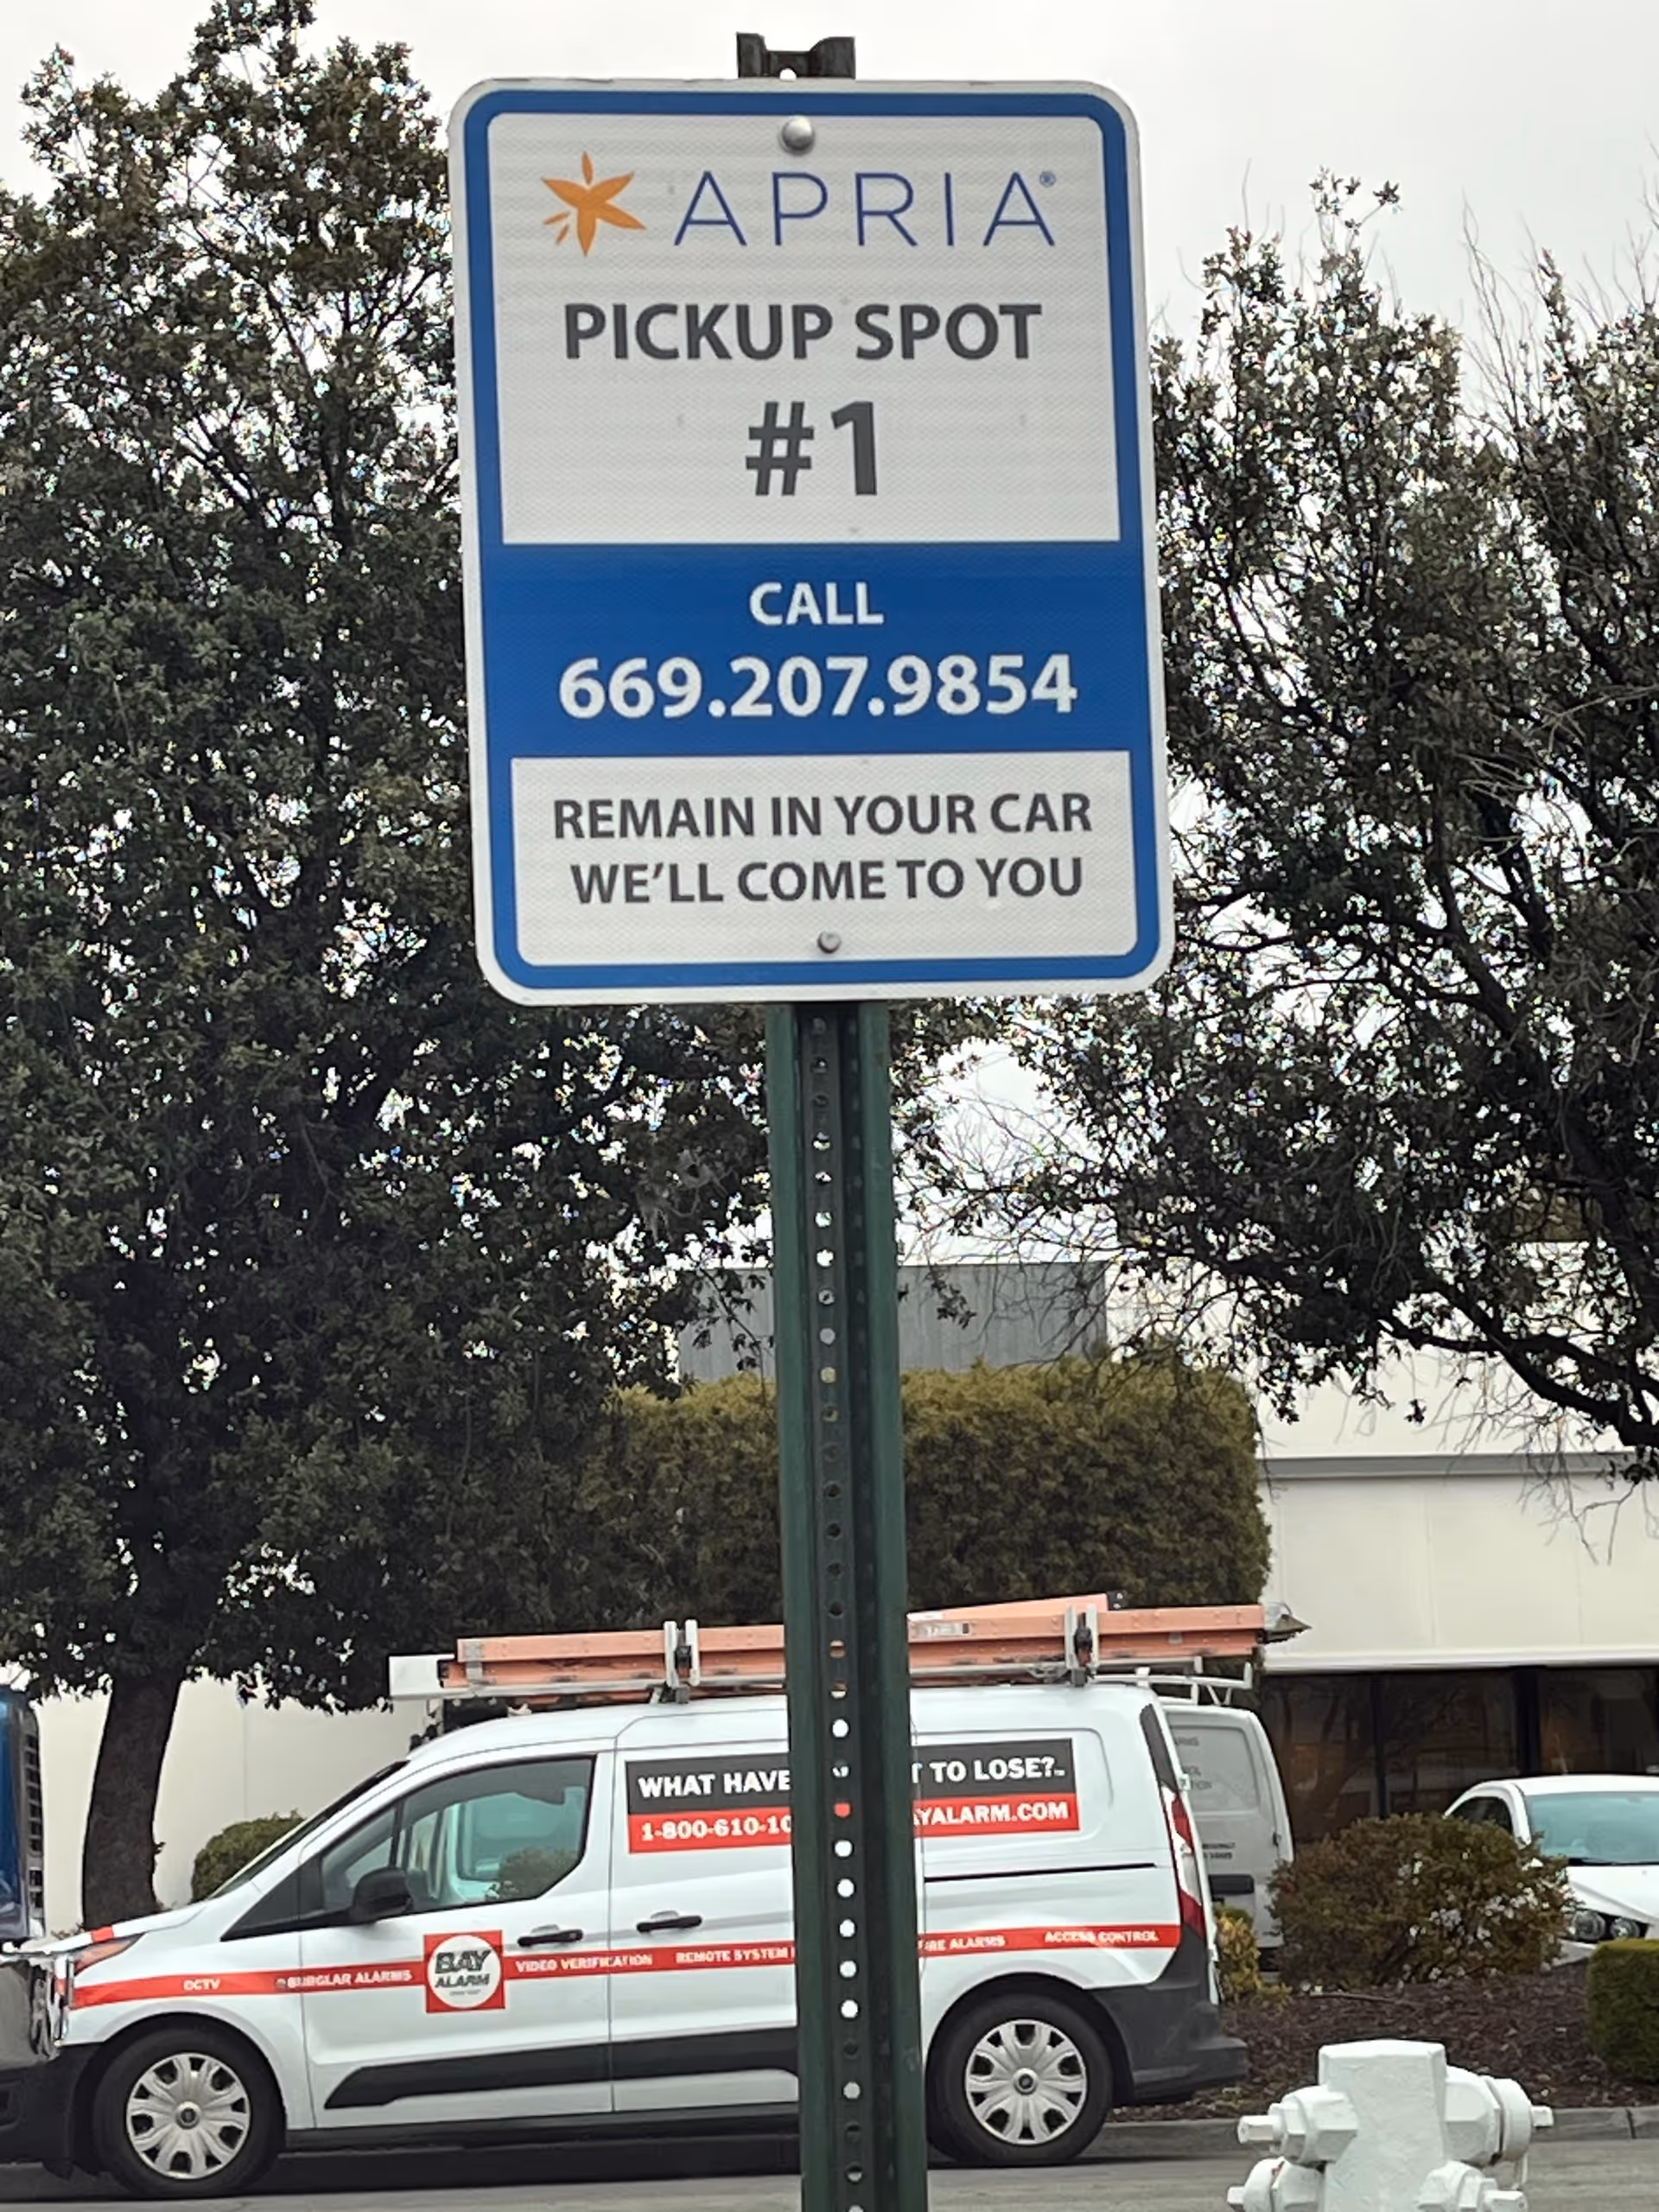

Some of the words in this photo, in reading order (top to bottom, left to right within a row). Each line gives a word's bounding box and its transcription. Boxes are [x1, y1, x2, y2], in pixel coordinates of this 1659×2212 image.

[564, 303, 833, 360] PICKUP
[855, 303, 1042, 360] SPOT
[746, 401, 878, 496] #1
[750, 582, 884, 626] CALL
[559, 654, 1077, 718] 669.207.9854
[554, 797, 754, 839] REMAIN
[772, 797, 822, 836] IN
[834, 794, 976, 836] YOUR
[990, 792, 1092, 833] CAR
[570, 862, 724, 904] WE’LL
[738, 861, 887, 902] COME
[896, 859, 964, 899] TO
[976, 856, 1082, 898] YOU
[638, 1774, 715, 1798] WHAT
[722, 1770, 791, 1794] HAVE
[929, 1760, 967, 1783] TO
[949, 1935, 1006, 1950] ALARMS
[1044, 1929, 1096, 1943] ACCESS
[1096, 1929, 1160, 1943] CONTROL
[434, 1948, 493, 1974] BAY
[515, 1959, 558, 1973] VIDEO
[560, 1954, 653, 1970] VERIFICATION
[676, 1949, 732, 1964] REMOTE
[734, 1946, 789, 1961] SYSTEM
[354, 1969, 413, 1984] ALARMS
[434, 1973, 491, 1988] ALARM
